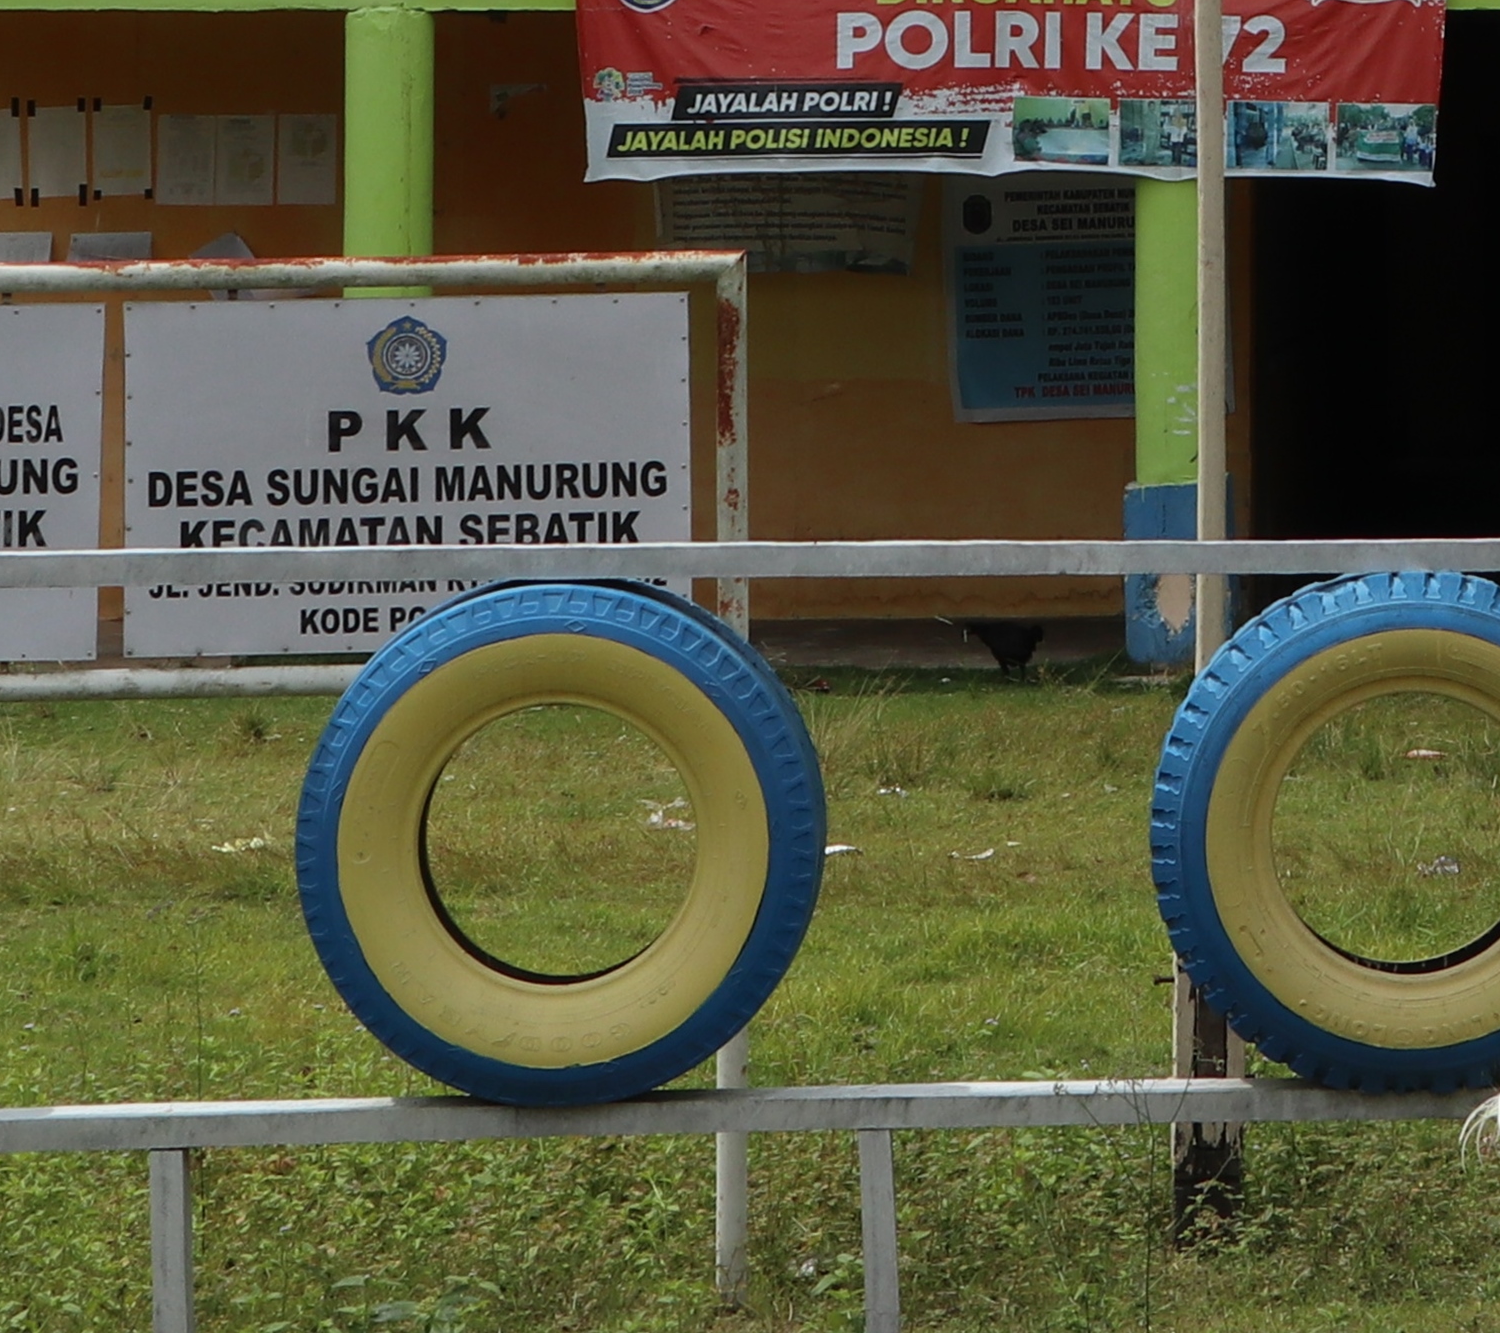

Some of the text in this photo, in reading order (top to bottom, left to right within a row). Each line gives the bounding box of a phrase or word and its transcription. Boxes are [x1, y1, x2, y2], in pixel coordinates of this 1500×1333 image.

[837, 10, 1062, 71] POLRI
[1085, 10, 1178, 72] KE
[687, 90, 803, 114] JAYALAH
[809, 89, 875, 113] POLRI
[617, 128, 724, 152] JAYALAH
[730, 128, 807, 151] POLISI
[814, 128, 952, 150] INDONESIA
[1037, 204, 1091, 215] KECAMATAN
[1012, 216, 1134, 232] DESA SEI MANURU
[1015, 387, 1036, 398] TPK
[1042, 386, 1069, 397] DESA
[147, 460, 669, 508] DESA SUNGAI MANURUNG
[179, 510, 640, 548] KECAMATAN SEBATIK
[300, 608, 379, 634] KODE
